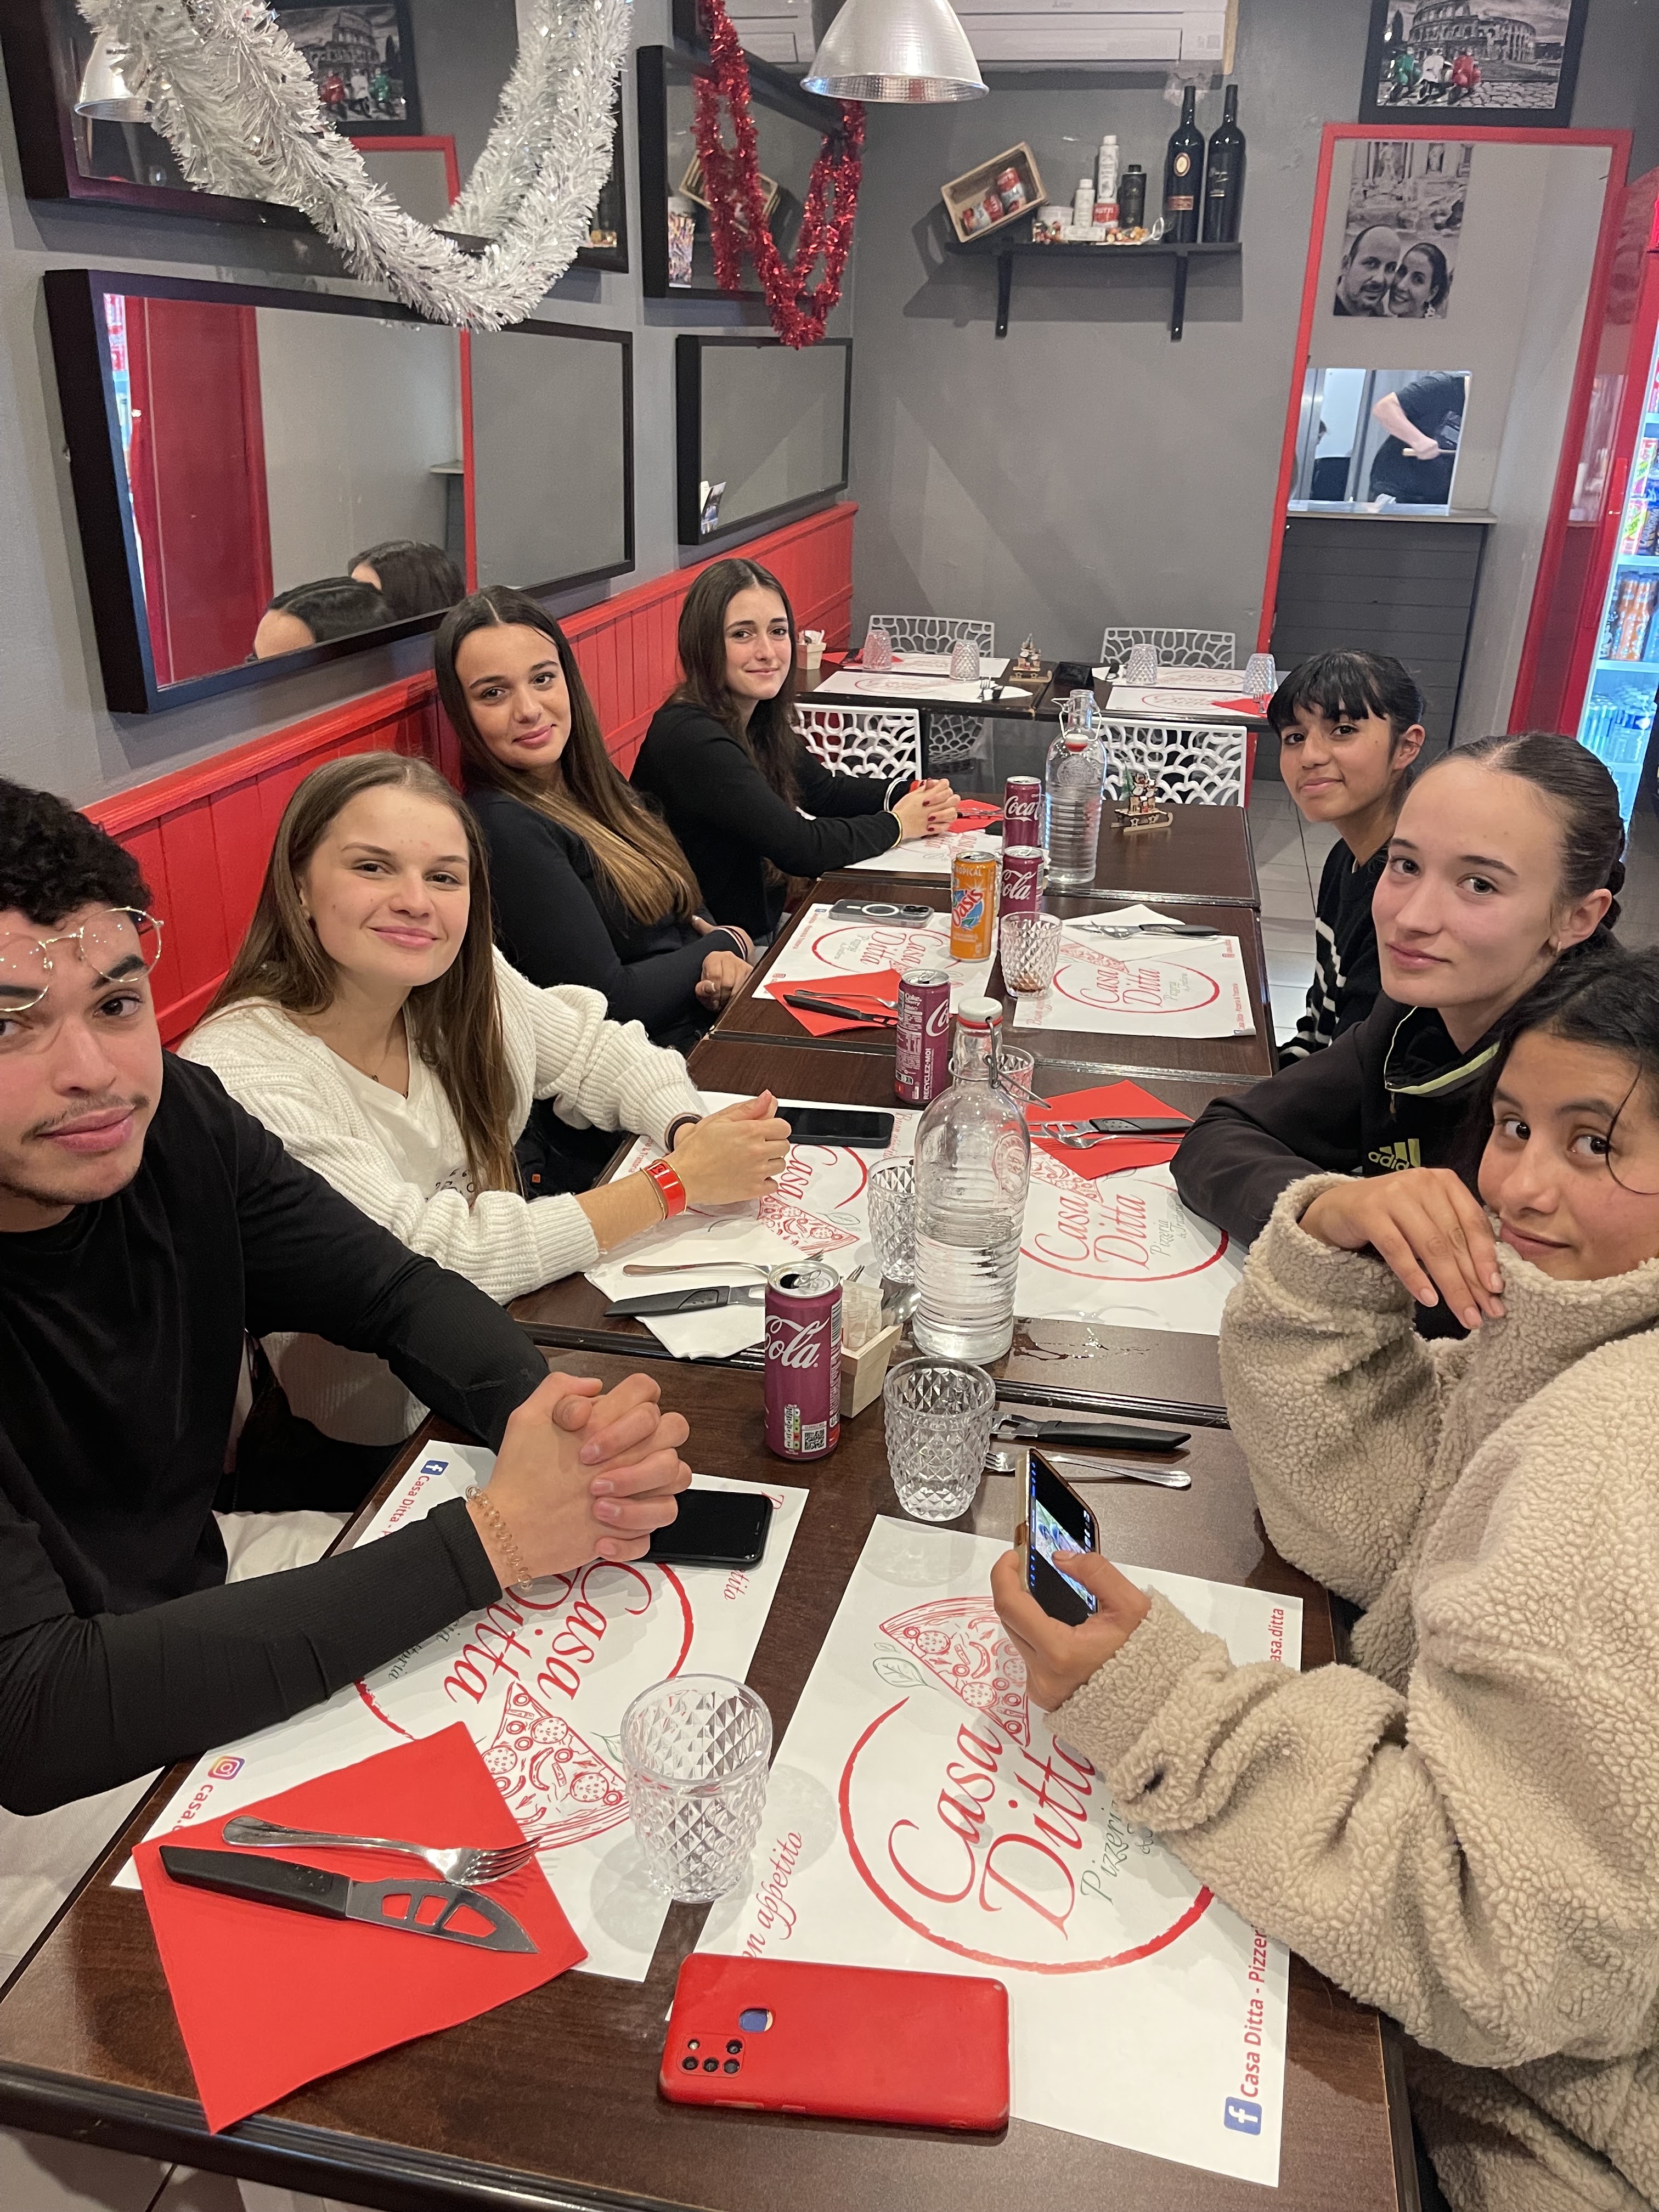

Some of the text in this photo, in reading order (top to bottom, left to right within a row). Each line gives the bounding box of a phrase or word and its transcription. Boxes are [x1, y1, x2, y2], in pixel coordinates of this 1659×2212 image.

[952, 887, 984, 928] Oasis
[860, 930, 907, 966] Ditta
[901, 934, 944, 964] Casa
[1080, 969, 1120, 1003] Casa
[1122, 968, 1163, 1008] Ditta
[923, 1048, 932, 1100] RECYCLEZ-MOI
[777, 1143, 838, 1201] Casa
[1034, 1196, 1089, 1261] Casa
[1093, 1194, 1149, 1270] Ditta
[1150, 1219, 1173, 1257] Pizzeria
[408, 1475, 430, 1497] Casa
[390, 1499, 415, 1522] Ditta
[537, 1561, 652, 1701] Casa
[1268, 1608, 1284, 1662] asa.ditta
[888, 1723, 1003, 1903] Casa
[756, 1832, 802, 1940] appetito
[1244, 1999, 1264, 2046] Ditta
[1240, 2052, 1261, 2098] Casa
